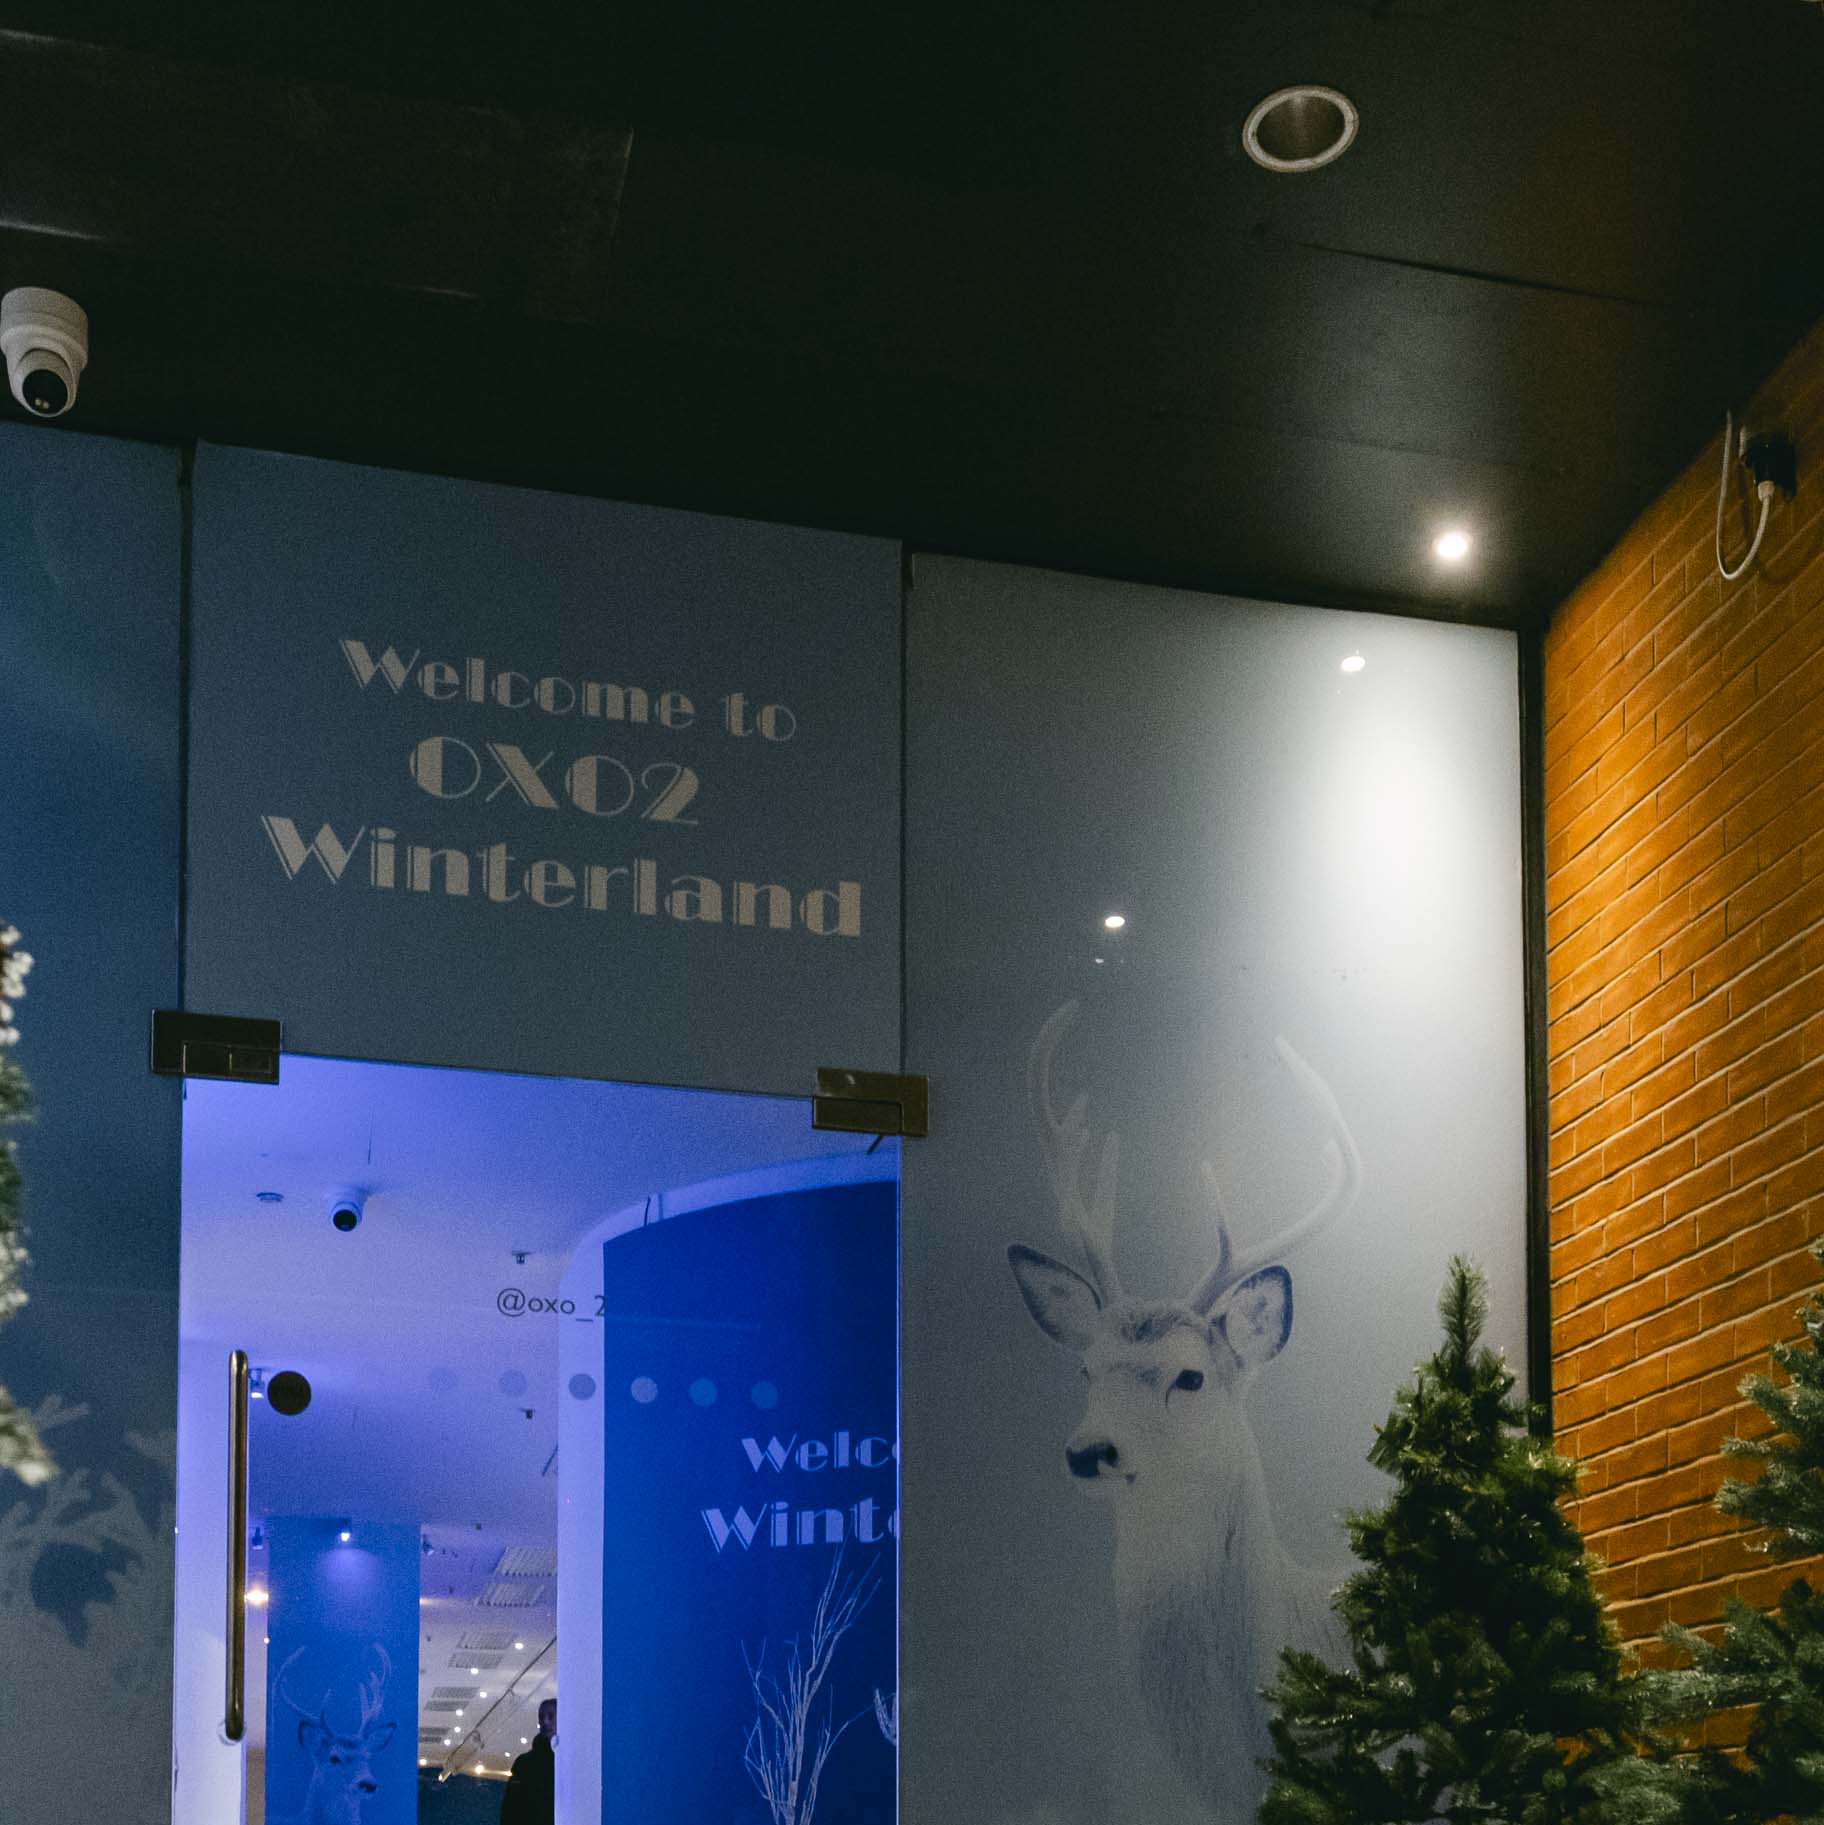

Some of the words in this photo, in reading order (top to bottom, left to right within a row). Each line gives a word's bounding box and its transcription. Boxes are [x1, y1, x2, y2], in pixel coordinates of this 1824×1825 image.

[339, 639, 696, 729] Welcome
[724, 691, 797, 742] to
[410, 736, 699, 825] OXO2
[261, 815, 862, 938] Winterland
[741, 1430, 899, 1473] Welc
